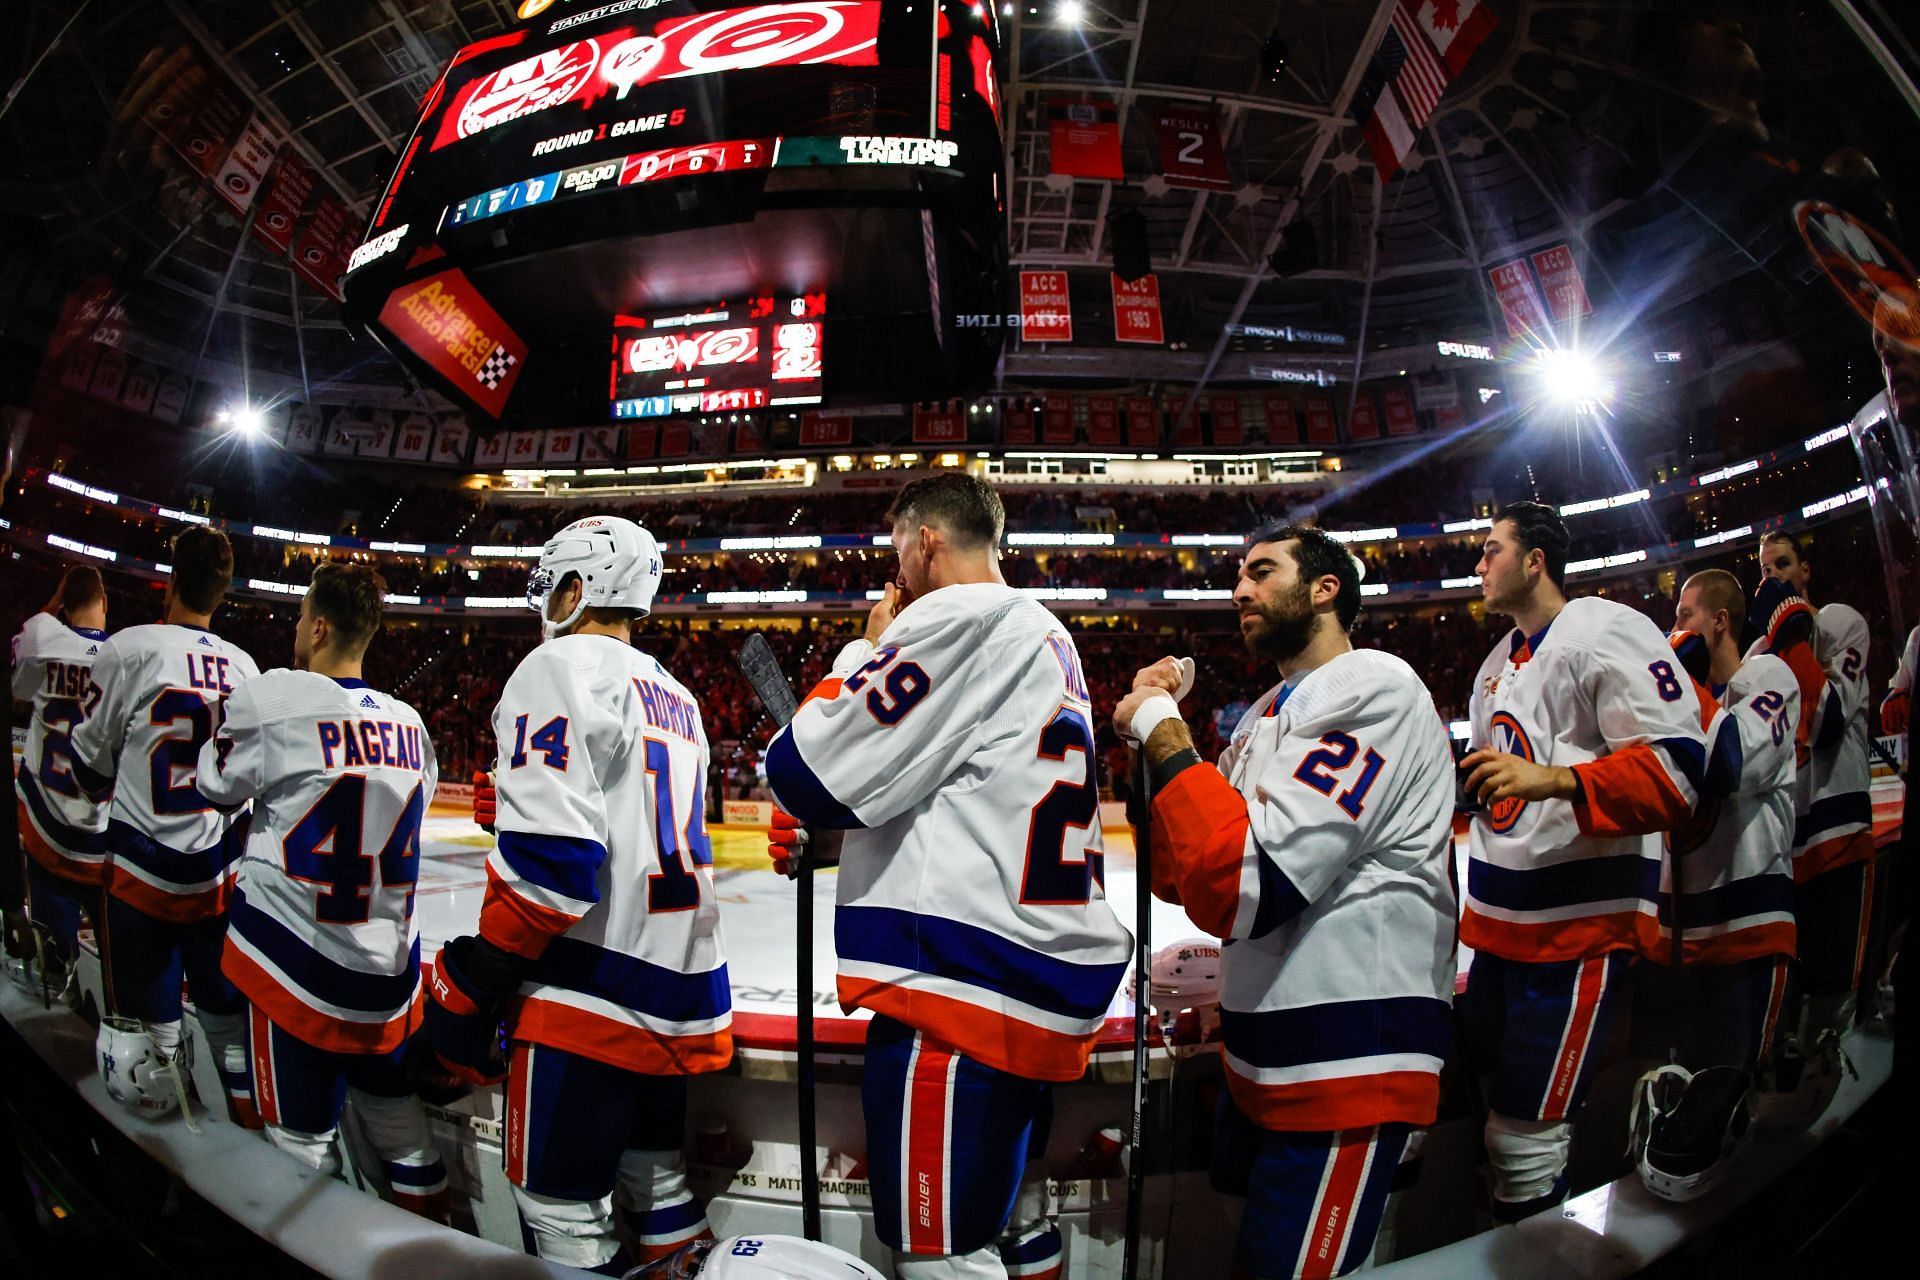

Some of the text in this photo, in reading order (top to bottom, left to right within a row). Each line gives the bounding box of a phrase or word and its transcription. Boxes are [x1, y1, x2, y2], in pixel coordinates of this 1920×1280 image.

[549, 1, 639, 33] STANLEY CUP
[612, 44, 655, 69] VS
[532, 109, 687, 157] ROUND 1 GAME 5
[1161, 117, 1211, 131] WESLEY
[840, 136, 958, 157] STARTING
[847, 148, 951, 168] LINEUPS
[1177, 132, 1205, 165] 2
[564, 164, 617, 189] 20:00
[1542, 251, 1565, 273] ACC
[1030, 275, 1058, 291] ACC
[1122, 278, 1149, 293] ACC
[398, 294, 479, 373] Auto Parts
[419, 281, 491, 354] Advance
[579, 520, 605, 529] UBS
[186, 652, 231, 691] LEE
[843, 646, 932, 728] 29
[1647, 658, 1683, 702] 8
[632, 676, 700, 746] HORVAT
[1750, 689, 1791, 747] 25
[317, 719, 422, 772] PAGEAU
[510, 712, 570, 772] 14
[1293, 729, 1386, 822] 21
[1018, 703, 1105, 905] 2
[282, 772, 425, 924] 44
[1194, 947, 1220, 959] UBS
[1556, 1048, 1577, 1098] BAUER
[768, 1176, 801, 1191] MATT
[918, 1171, 931, 1229] BAUER
[1045, 1182, 1079, 1197] QUIS
[731, 1239, 763, 1257] 29
[1318, 1204, 1341, 1260] BAUER
